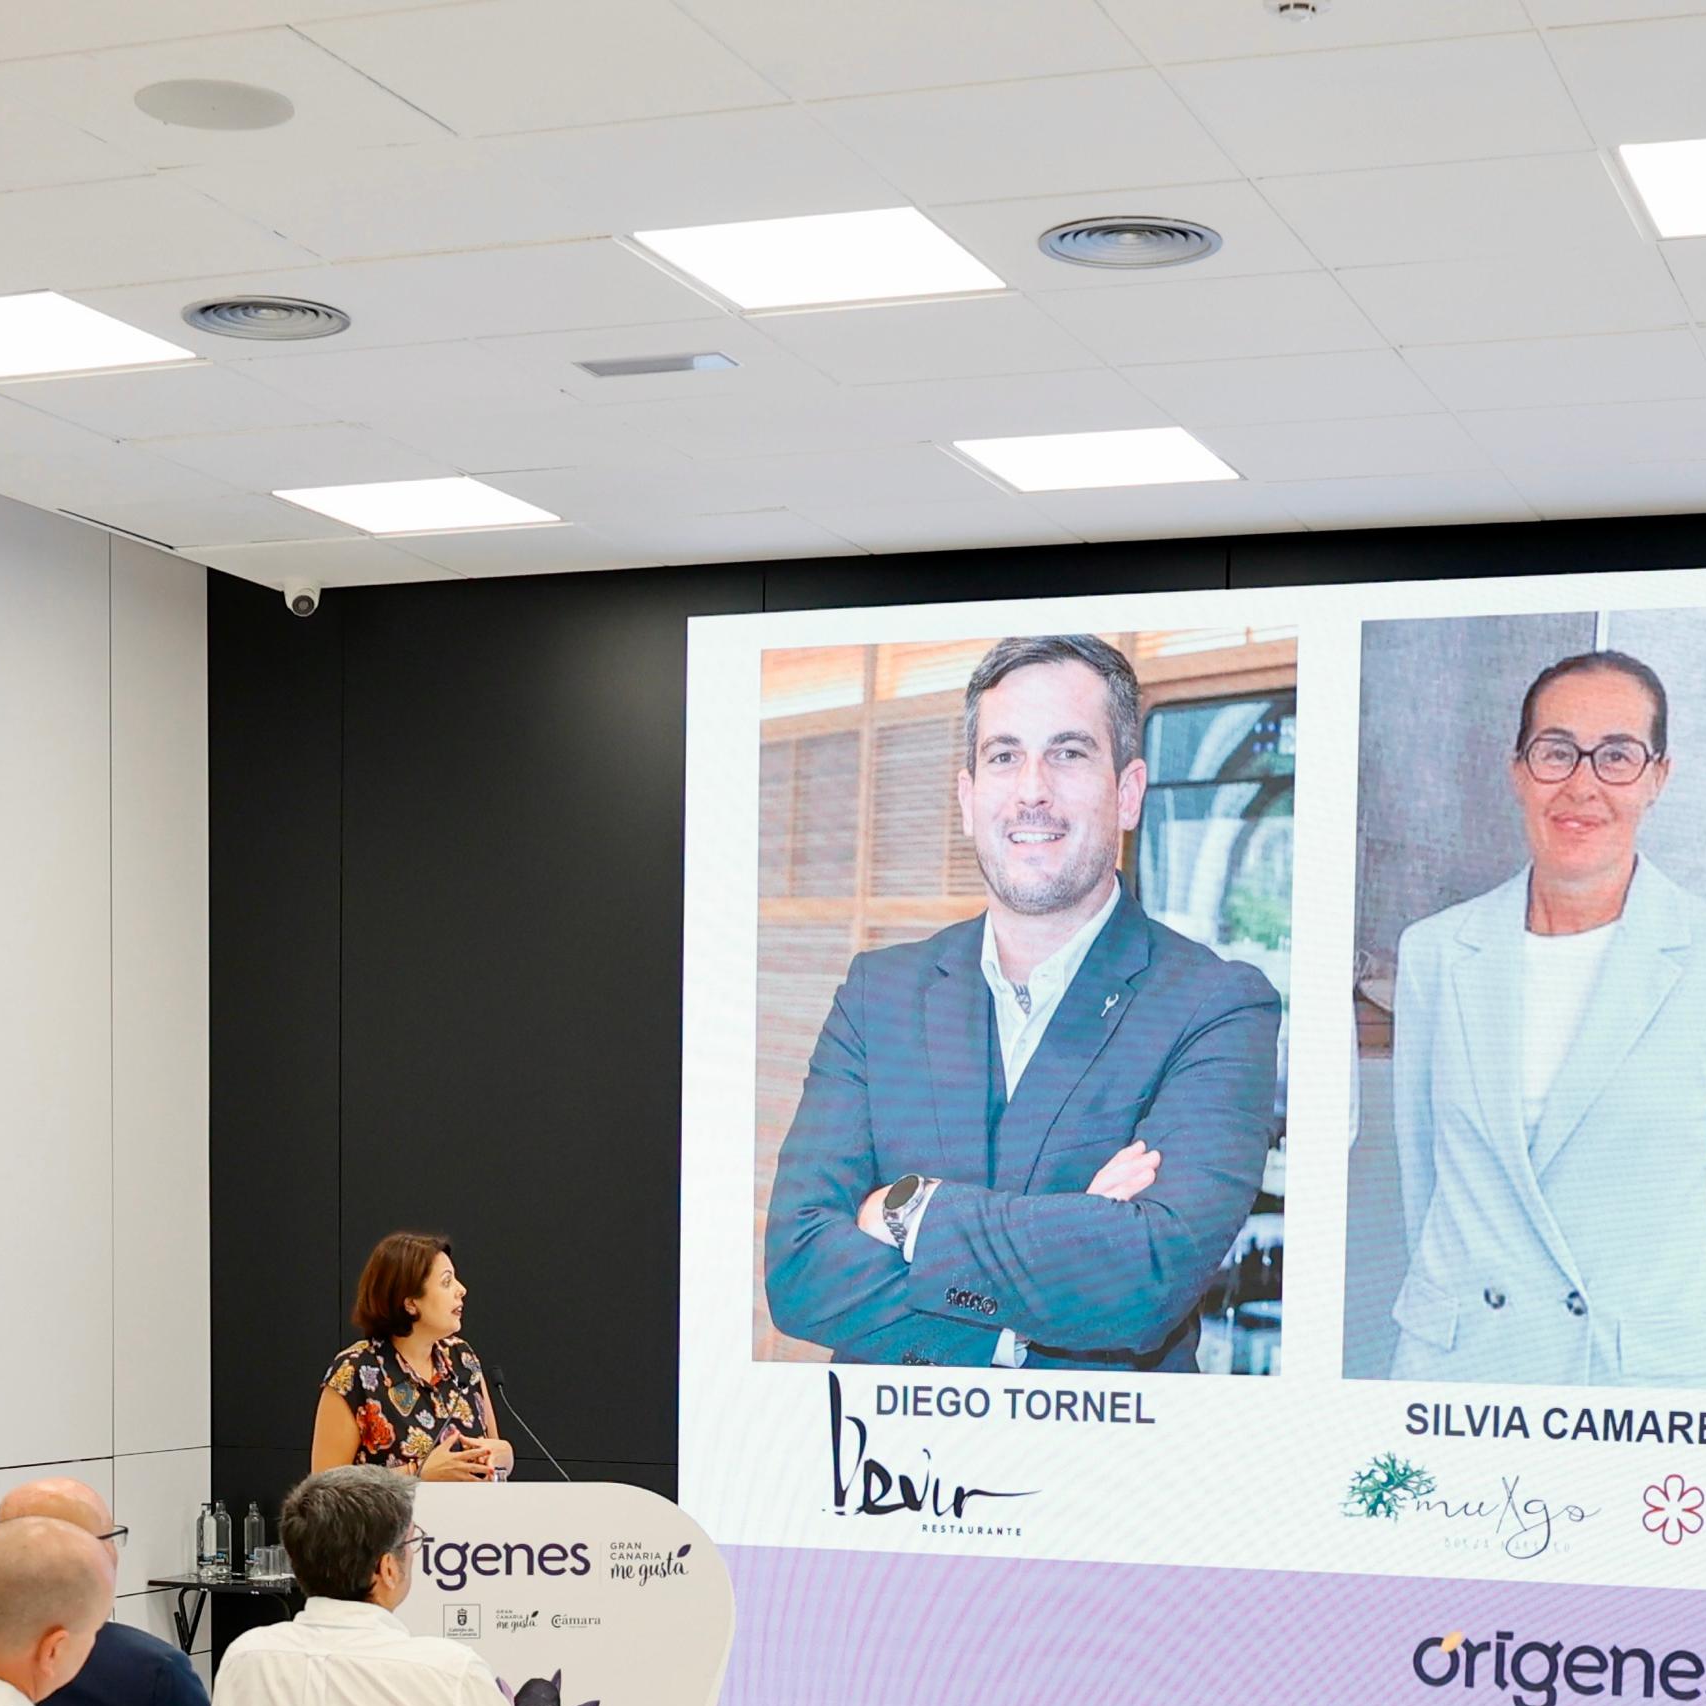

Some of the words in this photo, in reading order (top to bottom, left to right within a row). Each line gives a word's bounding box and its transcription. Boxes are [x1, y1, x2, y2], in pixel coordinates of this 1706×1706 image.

[875, 1384, 991, 1418] DIEGO
[1003, 1388, 1156, 1424] TORNEL
[1405, 1402, 1530, 1439] SILVIA
[921, 1524, 1023, 1537] RESTAURANTE
[610, 1542, 643, 1551] GRAN
[610, 1551, 662, 1561] CANARIA
[610, 1562, 636, 1580] me
[638, 1552, 690, 1587] gusta
[510, 1614, 537, 1633] gusta
